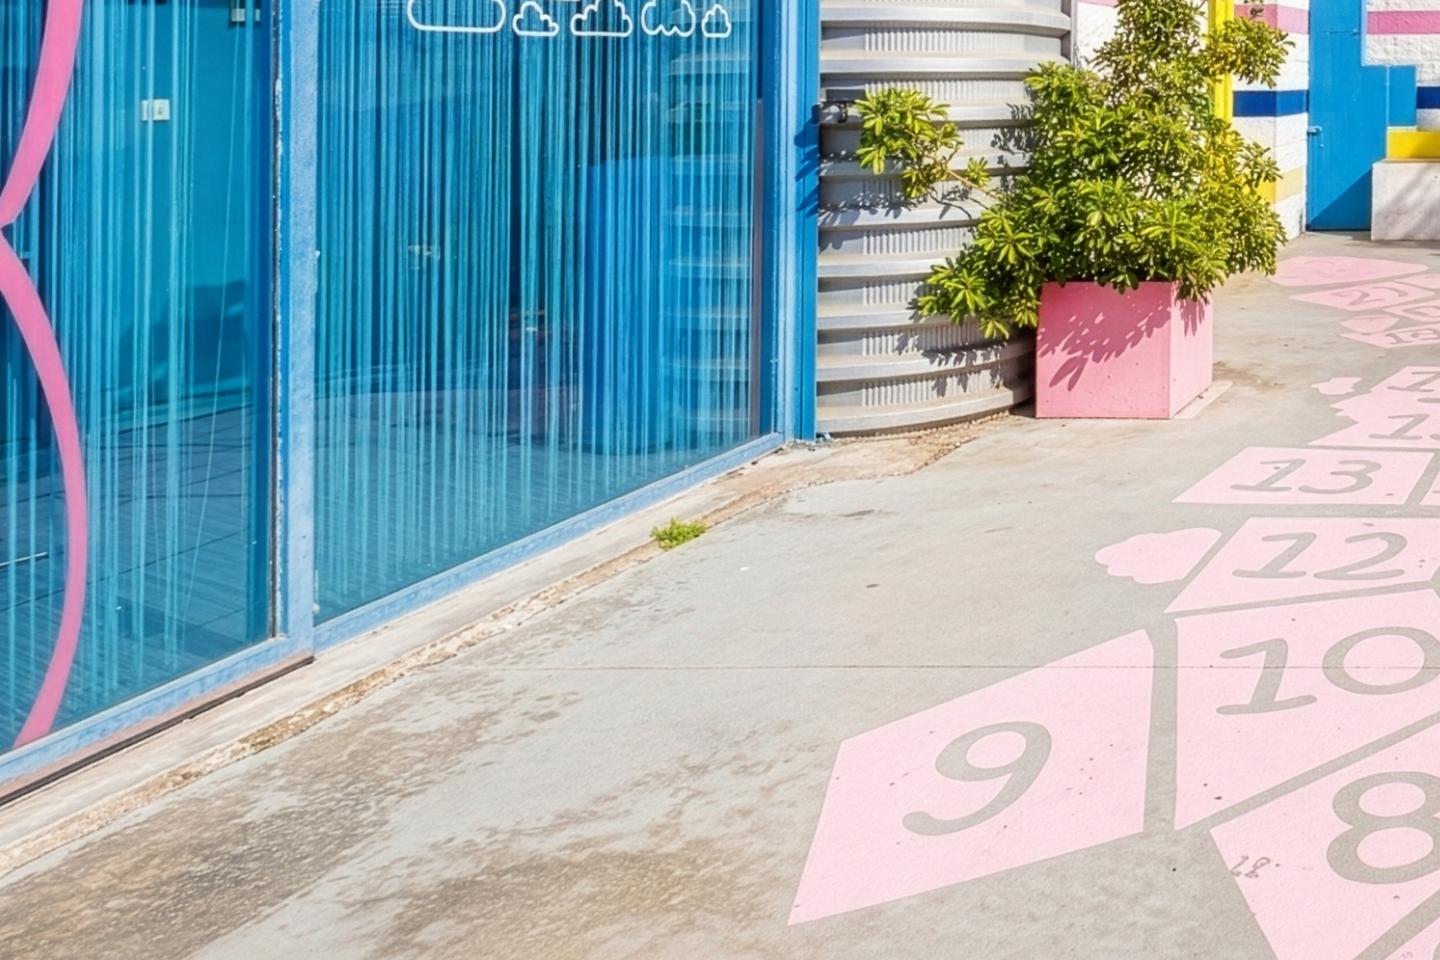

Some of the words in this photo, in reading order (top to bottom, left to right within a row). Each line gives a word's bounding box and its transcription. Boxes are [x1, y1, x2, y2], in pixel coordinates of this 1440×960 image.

[1230, 458, 1383, 495] 13
[1231, 531, 1409, 581] 12
[902, 721, 1055, 837] 9
